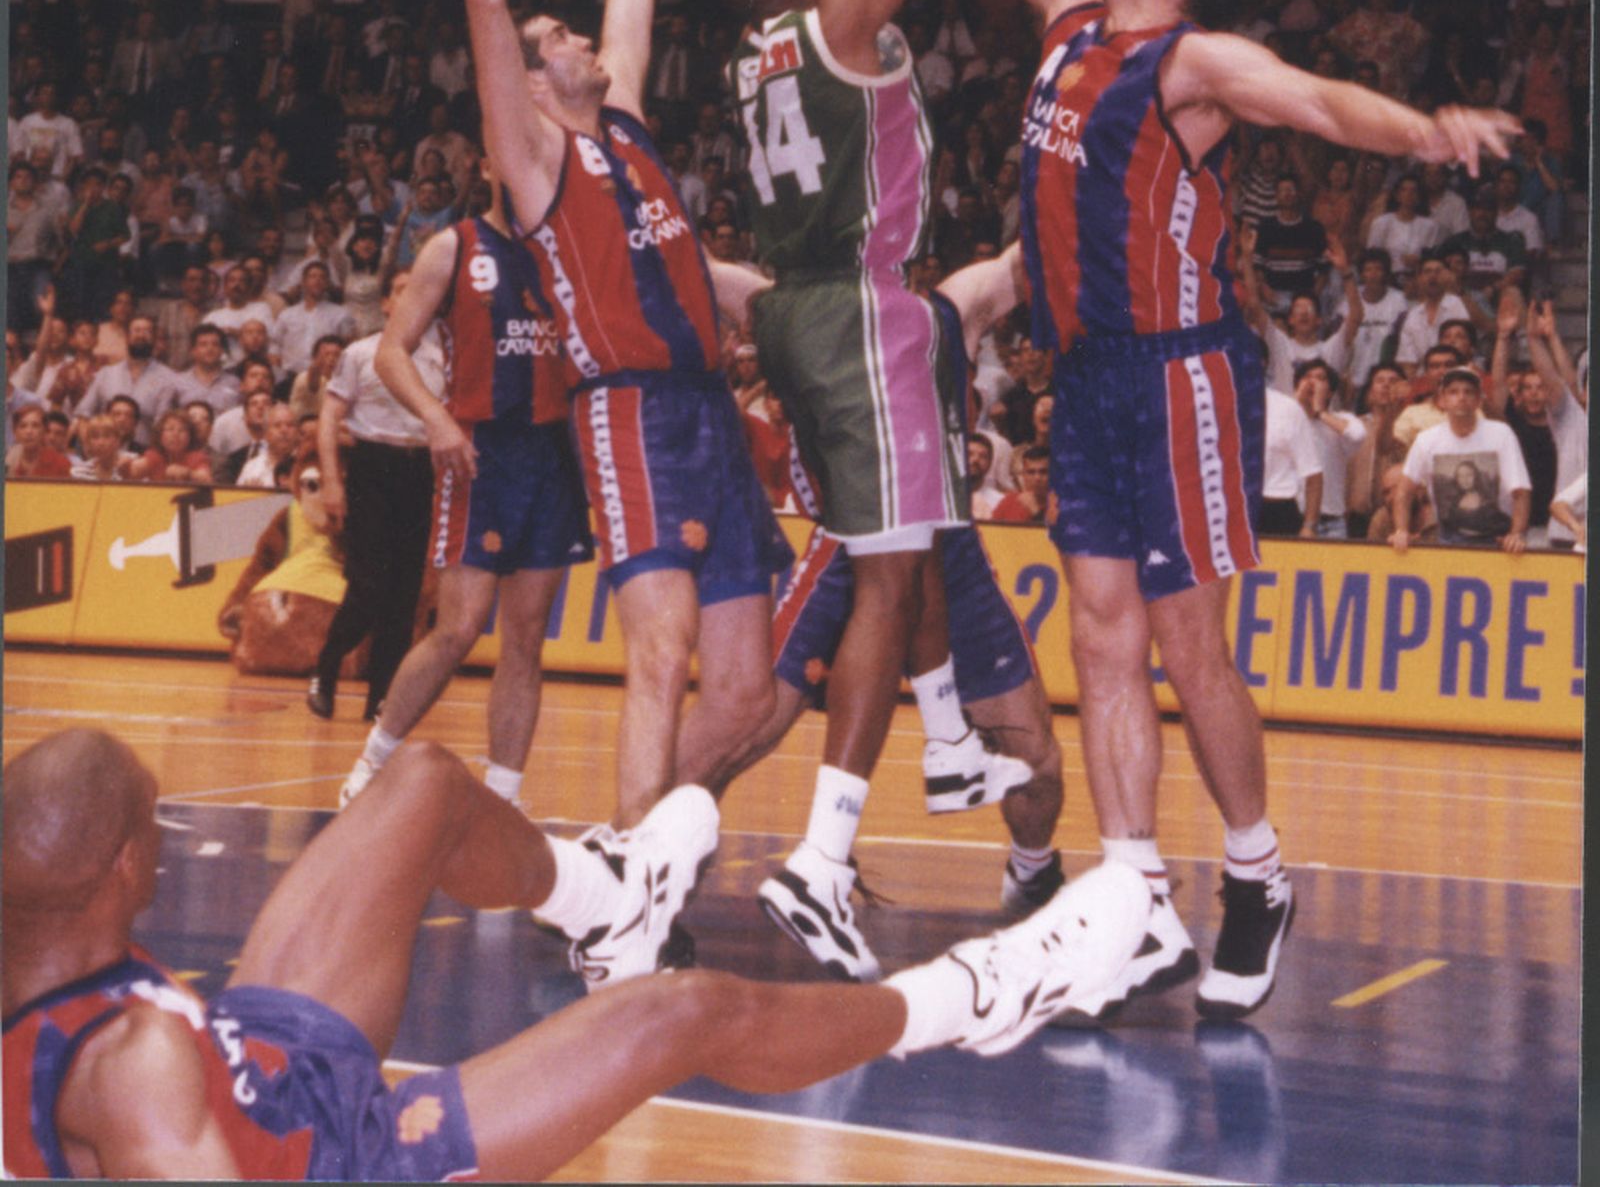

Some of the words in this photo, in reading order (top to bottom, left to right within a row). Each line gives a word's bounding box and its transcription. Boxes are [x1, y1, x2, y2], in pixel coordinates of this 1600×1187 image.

[469, 254, 499, 292] 9
[497, 338, 559, 356] CATALA
[1150, 569, 1585, 701] EMPRE!
